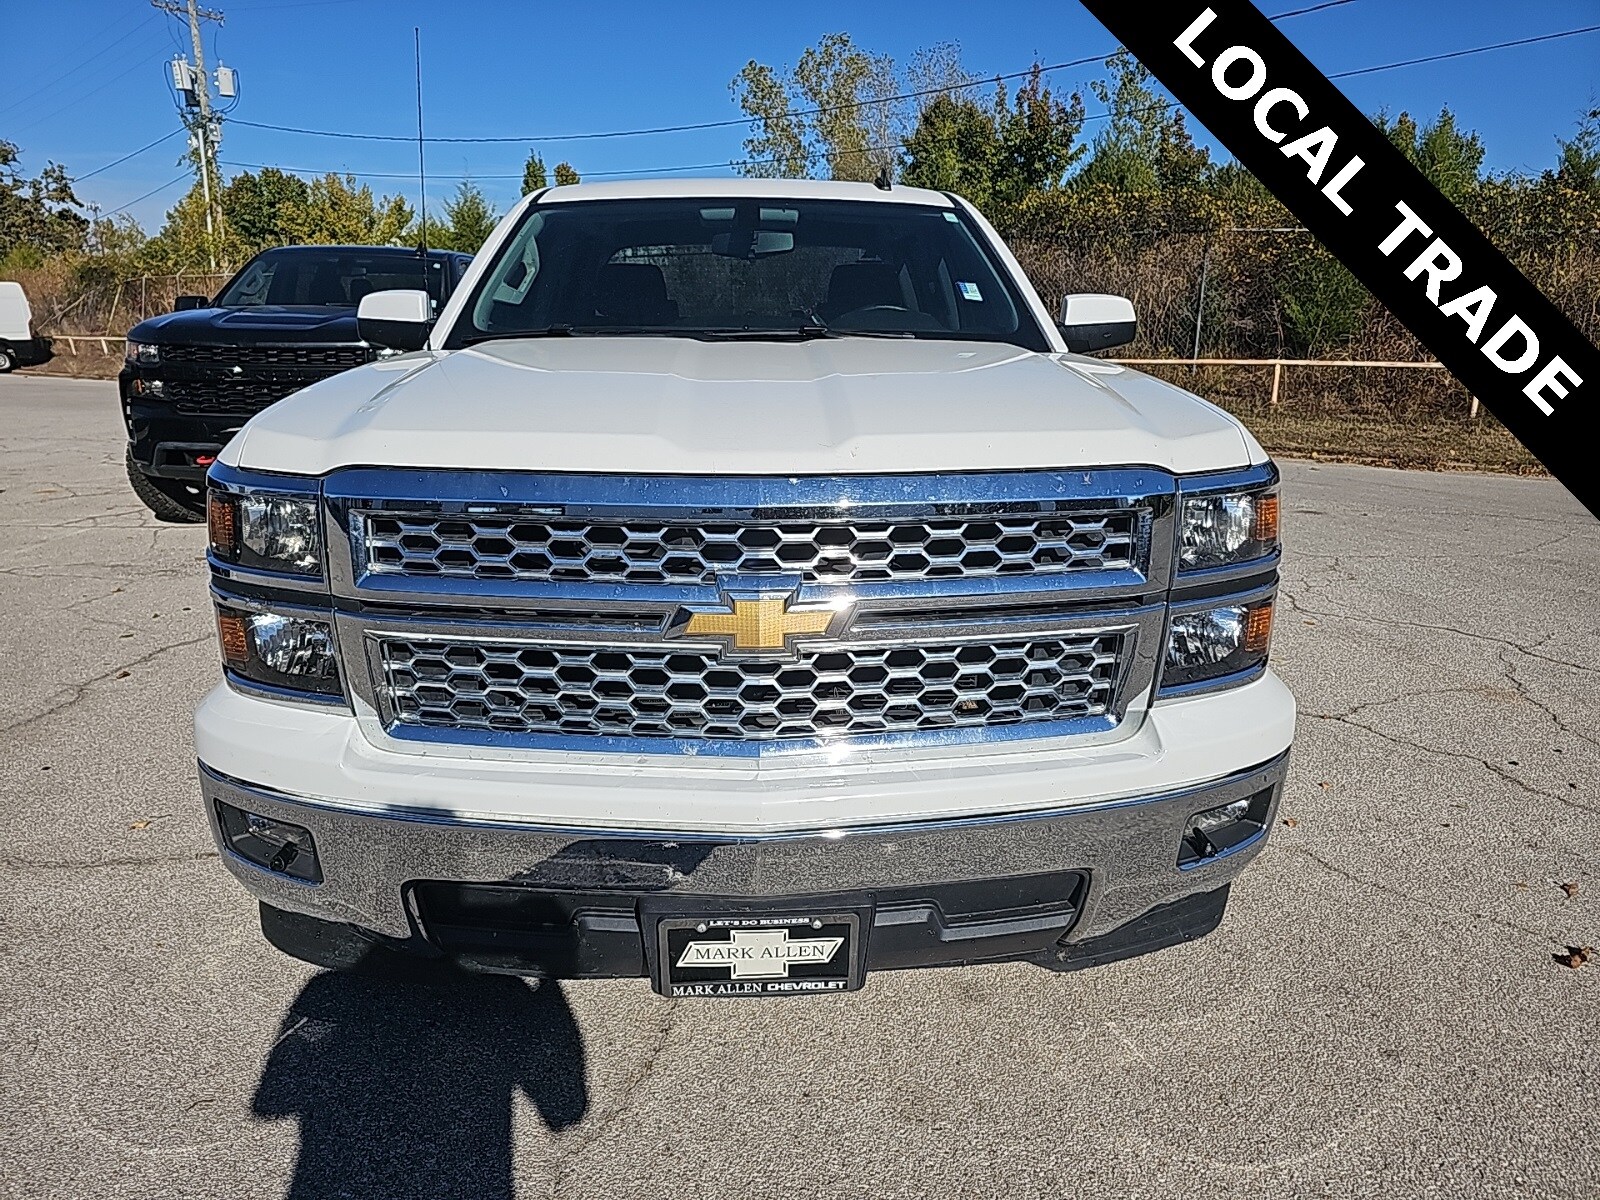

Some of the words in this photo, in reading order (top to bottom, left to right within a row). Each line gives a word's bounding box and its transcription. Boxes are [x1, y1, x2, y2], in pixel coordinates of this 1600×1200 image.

[759, 917, 810, 925] BUSINESS
[694, 948, 754, 960] MARK
[760, 944, 826, 959] ALLEN
[673, 985, 714, 997] MARK
[716, 983, 763, 995] ALLEN
[767, 980, 847, 991] CHEVROLET
